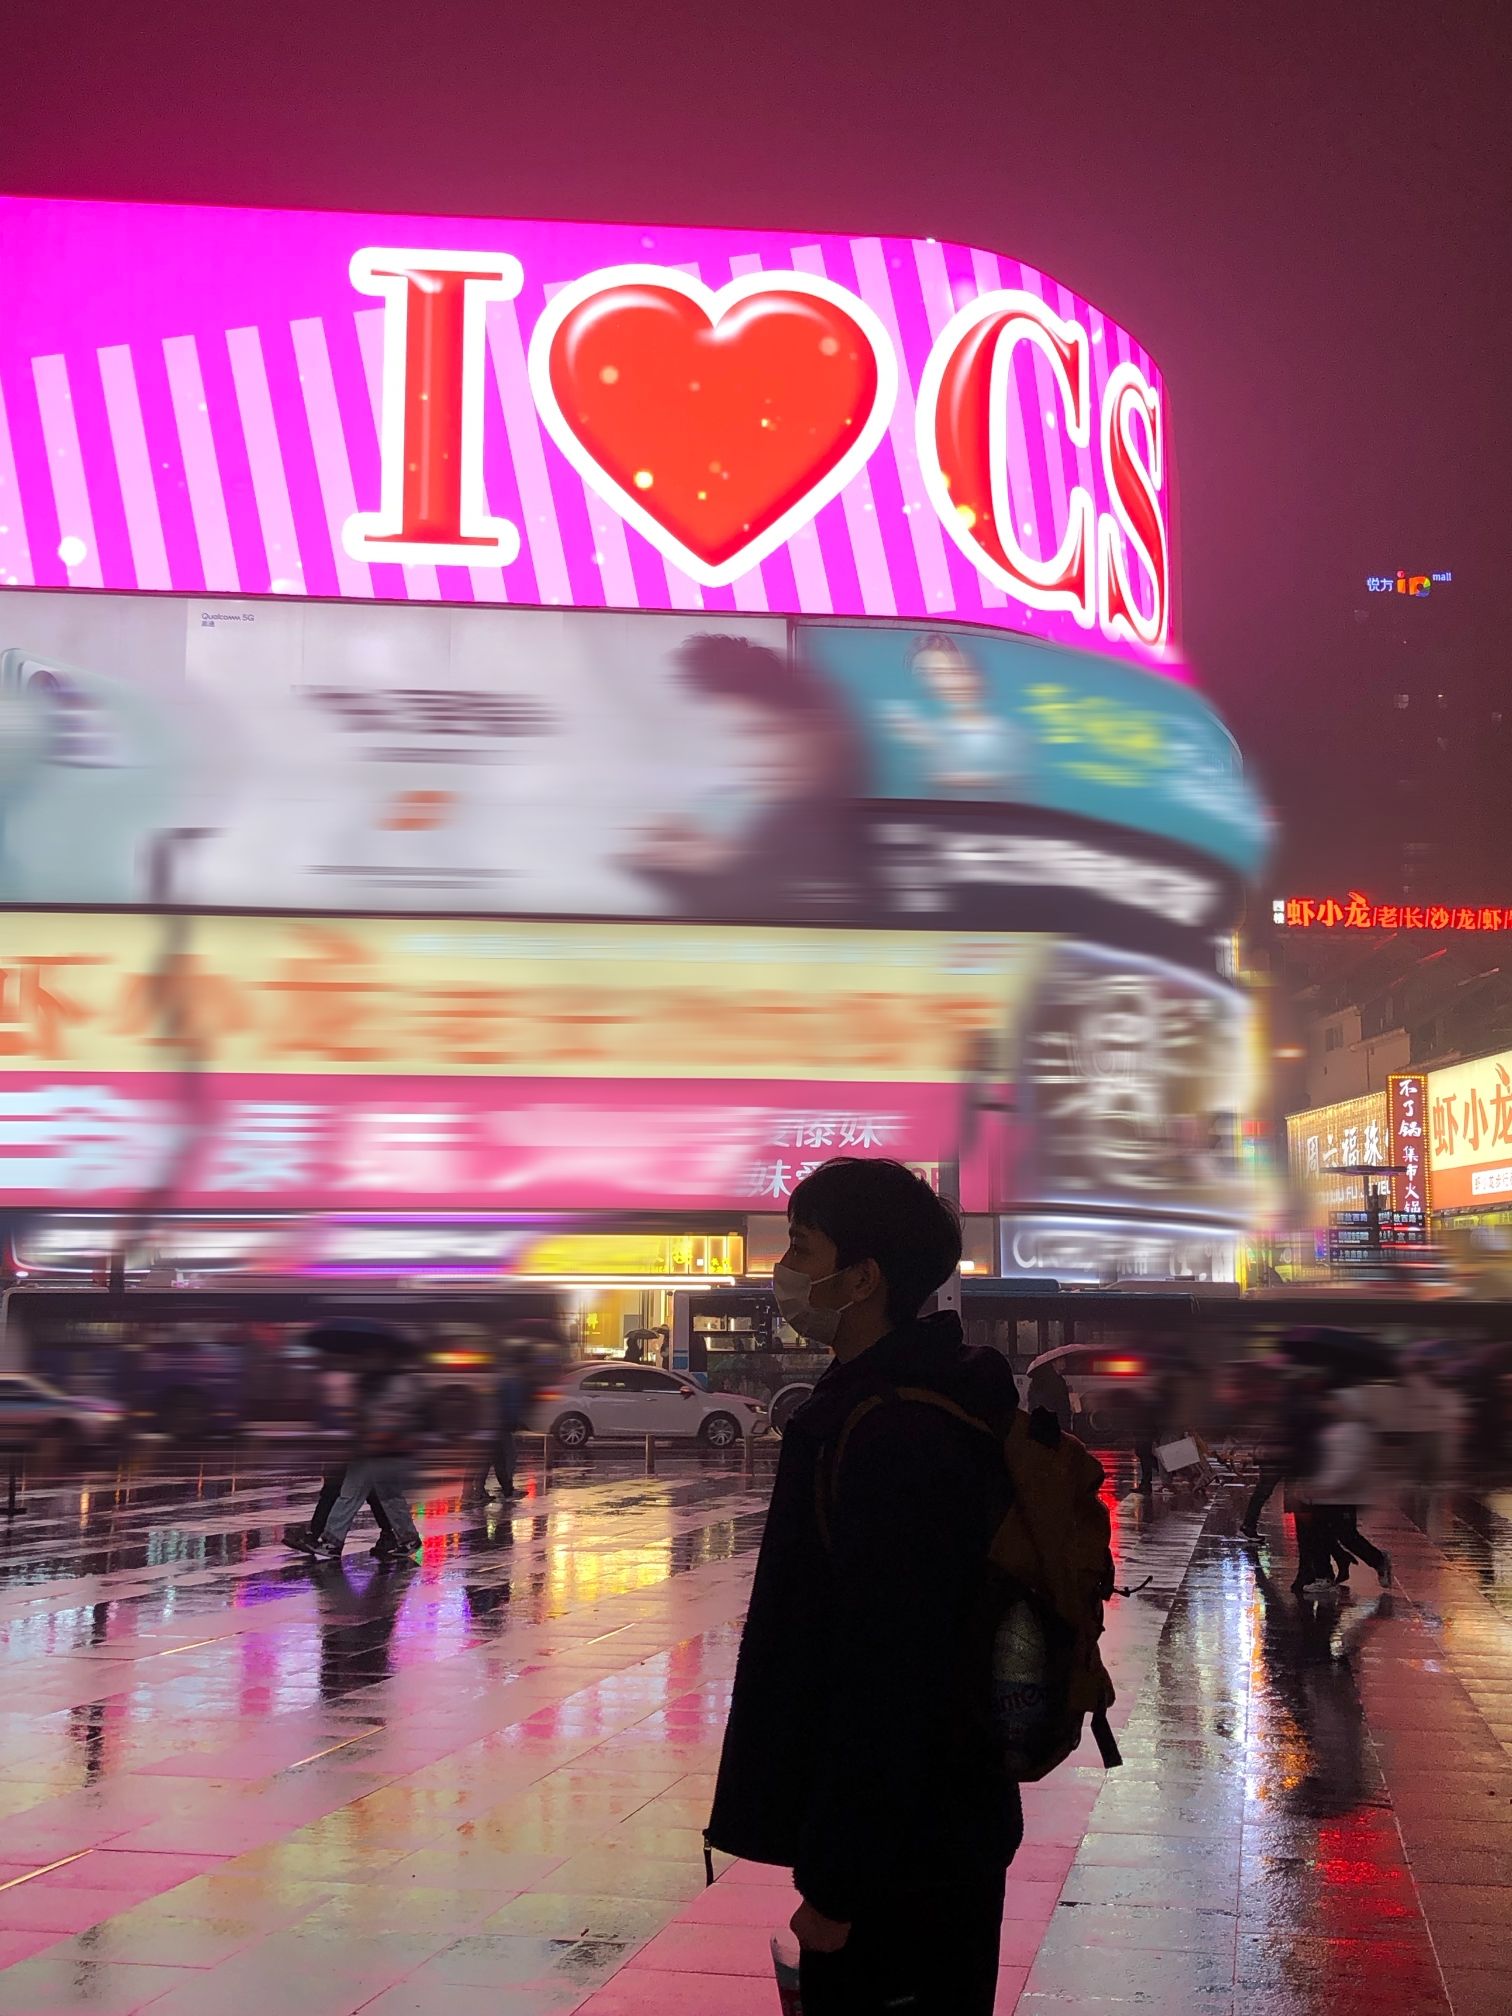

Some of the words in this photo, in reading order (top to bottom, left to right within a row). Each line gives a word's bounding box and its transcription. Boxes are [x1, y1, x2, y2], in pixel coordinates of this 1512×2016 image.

[343, 247, 523, 567] I
[916, 289, 1169, 645] CS
[1432, 573, 1452, 581] mall
[201, 612, 241, 621] Qualcomm
[1287, 892, 1370, 927] 虾小龙
[1306, 1119, 1388, 1177] 周六福珠
